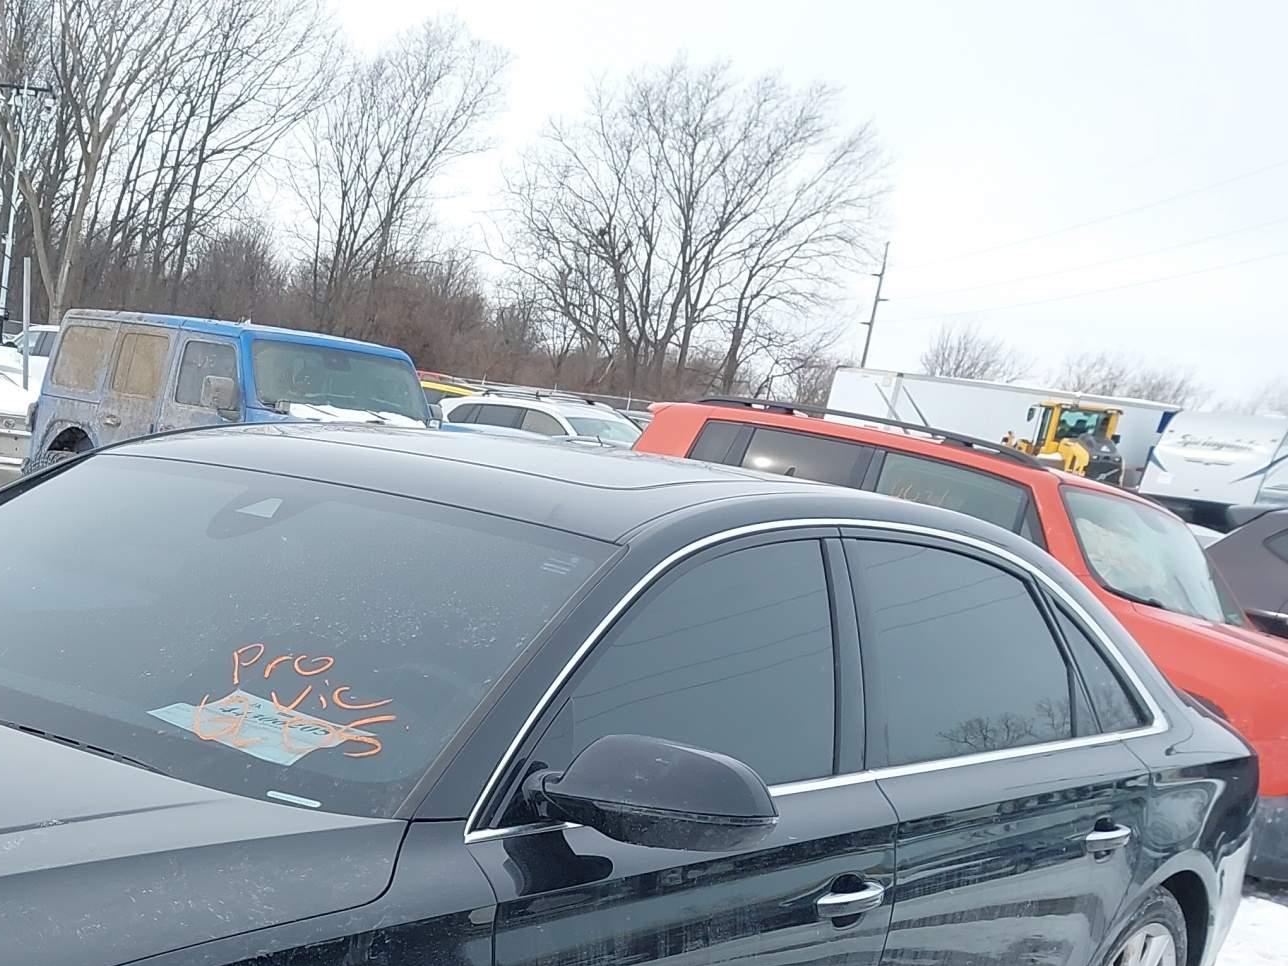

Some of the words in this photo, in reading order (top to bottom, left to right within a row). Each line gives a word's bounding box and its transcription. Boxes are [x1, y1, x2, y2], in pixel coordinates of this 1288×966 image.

[1178, 434, 1257, 451] Spring
[232, 643, 335, 685] Pro
[270, 679, 394, 711] Vic
